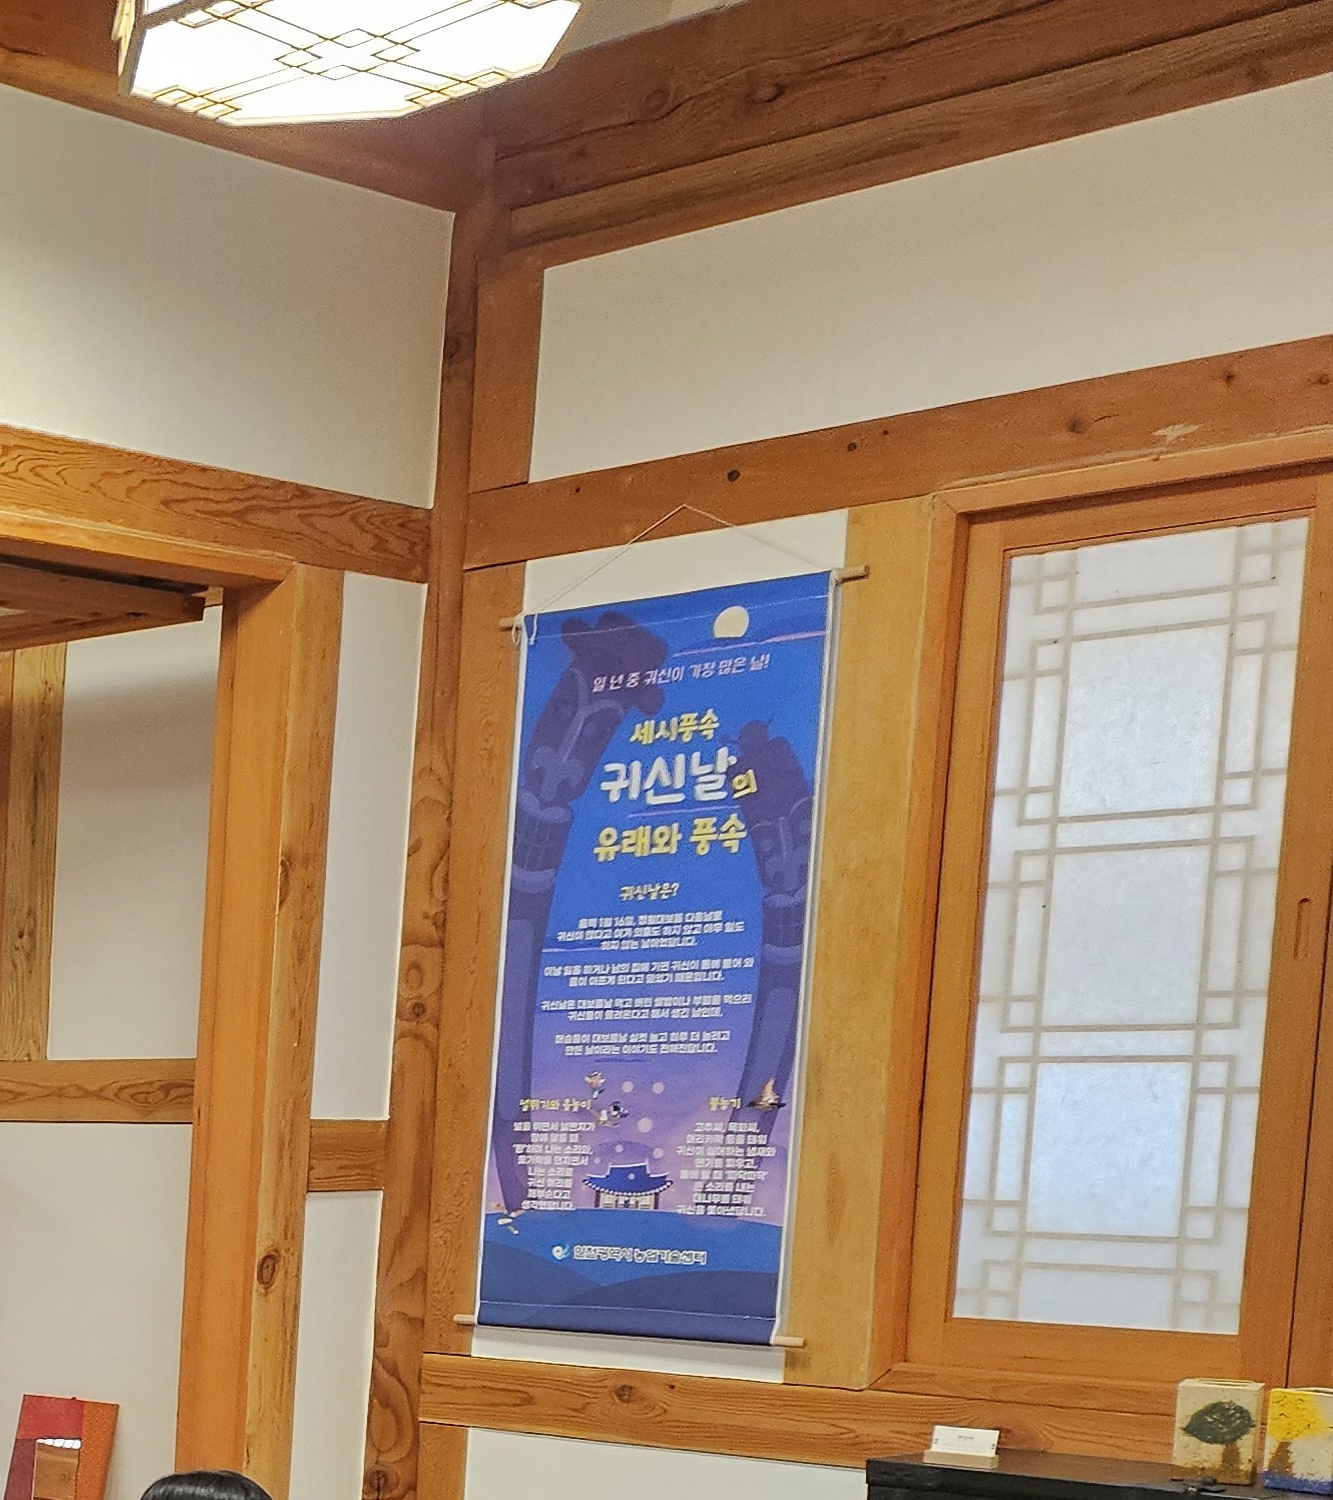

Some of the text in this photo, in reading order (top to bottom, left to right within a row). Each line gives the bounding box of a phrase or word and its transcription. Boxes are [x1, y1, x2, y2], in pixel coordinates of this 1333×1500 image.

[592, 654, 770, 692] 일 년 중 귀신이 가장 많은 날!
[630, 708, 719, 745] 세시풍속
[593, 813, 748, 862] 유래와 풍속
[620, 883, 679, 901] 귀신날은?
[573, 1245, 707, 1265] 인천광역시 농업기술센터
